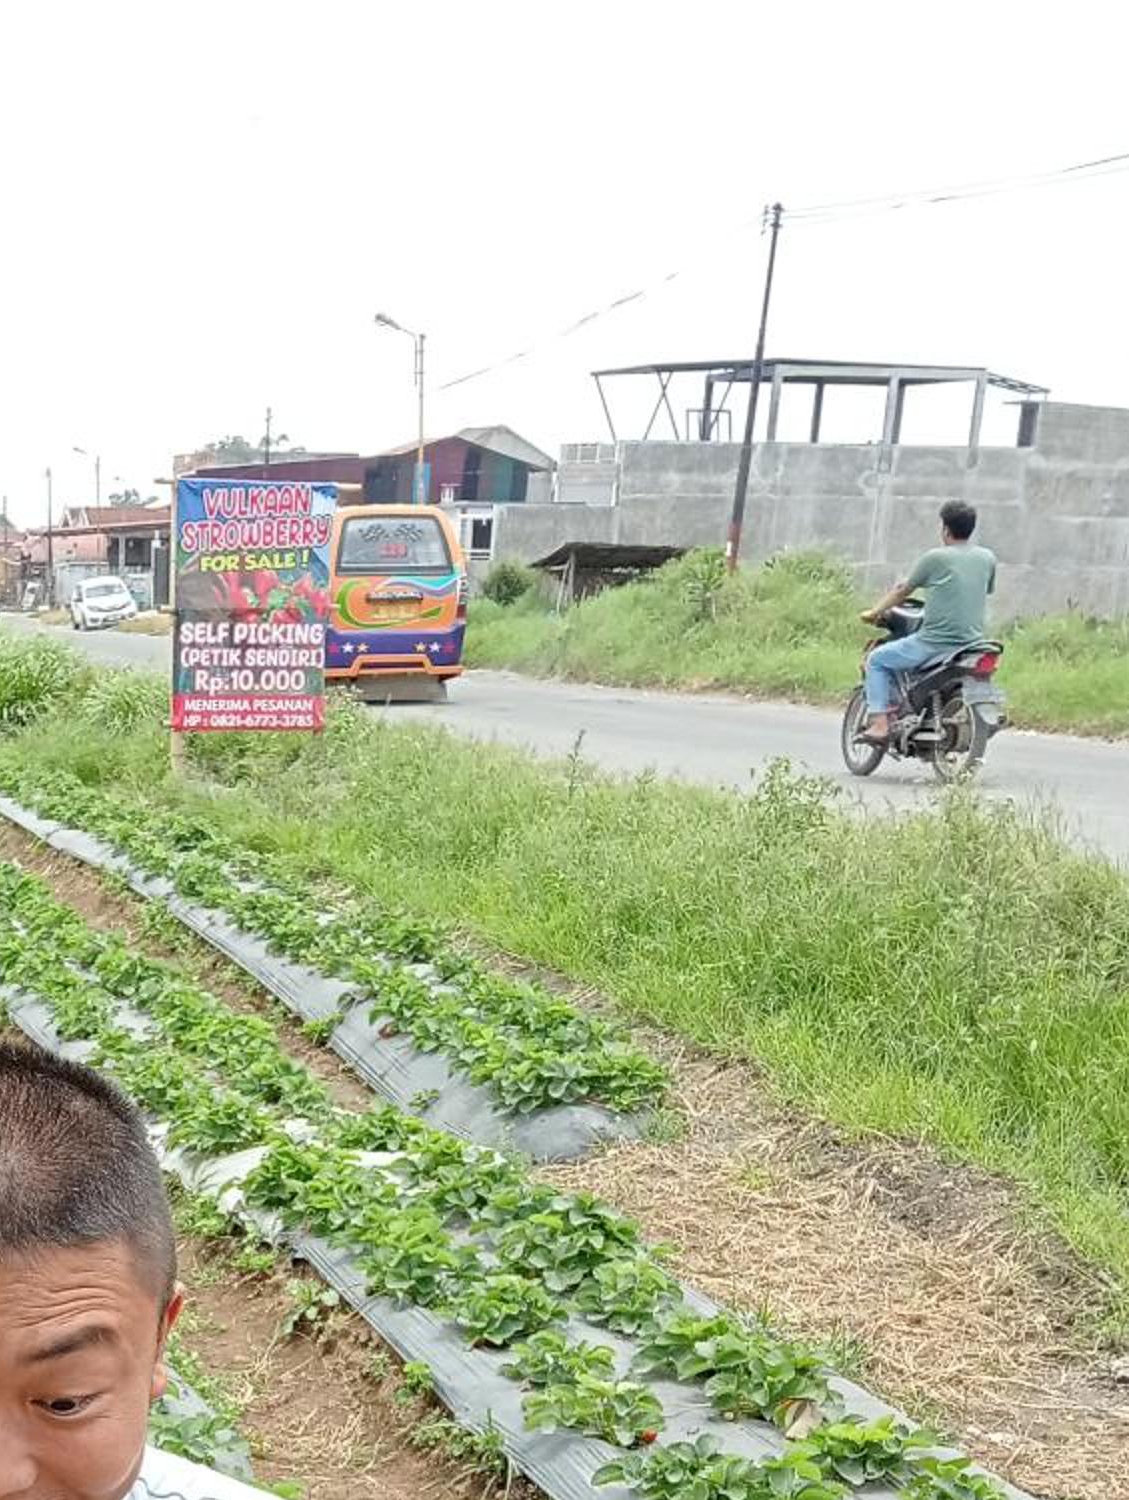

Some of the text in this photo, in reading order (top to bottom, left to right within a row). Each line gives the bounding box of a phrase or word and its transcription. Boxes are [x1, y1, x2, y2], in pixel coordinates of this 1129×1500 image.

[203, 484, 311, 519] VULKAAN
[182, 515, 332, 551] STROWBERRY
[200, 553, 239, 572] FOR
[245, 551, 296, 570] SALE
[180, 622, 324, 645] SELF PICKING
[181, 646, 325, 668] (PETIK SENDIRI)
[184, 699, 313, 711] MENERIMA PESANAN
